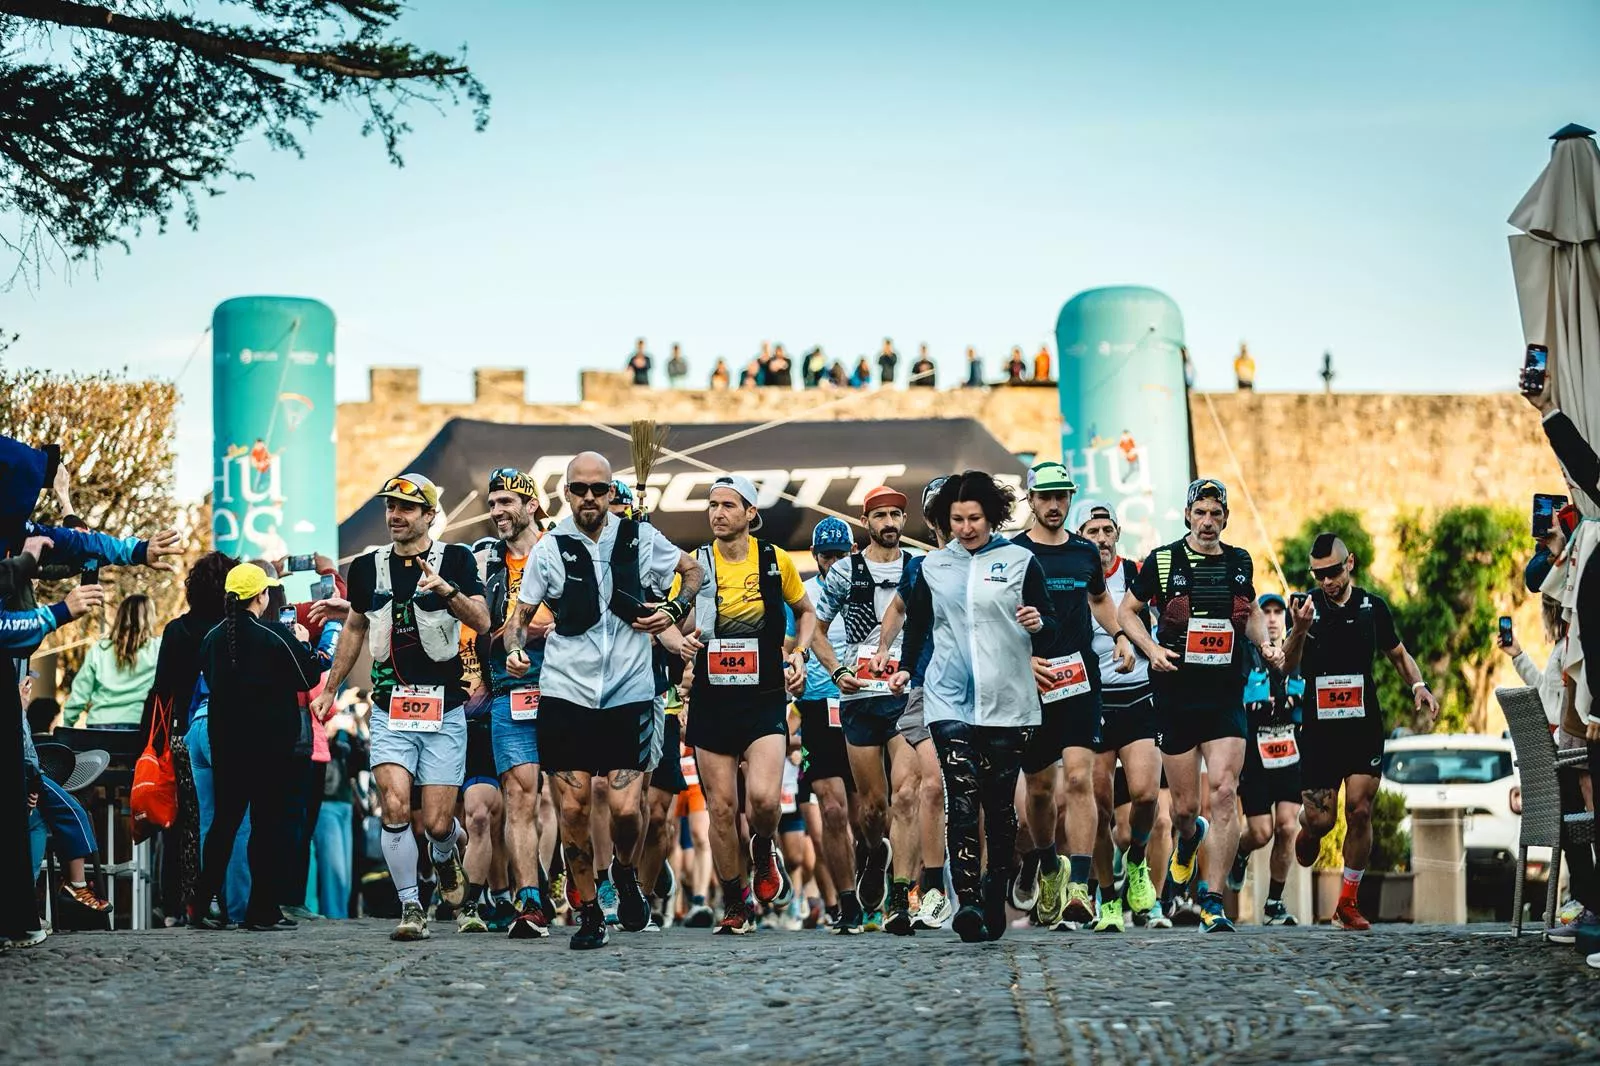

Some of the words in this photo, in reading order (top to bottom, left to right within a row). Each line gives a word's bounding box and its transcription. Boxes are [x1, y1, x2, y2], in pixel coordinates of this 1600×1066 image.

[830, 529, 842, 538] T8
[1200, 636, 1224, 647] 496
[720, 656, 745, 667] 484
[1056, 669, 1074, 681] 80
[524, 694, 540, 705] 23
[1330, 691, 1352, 702] 547
[402, 701, 430, 713] 507
